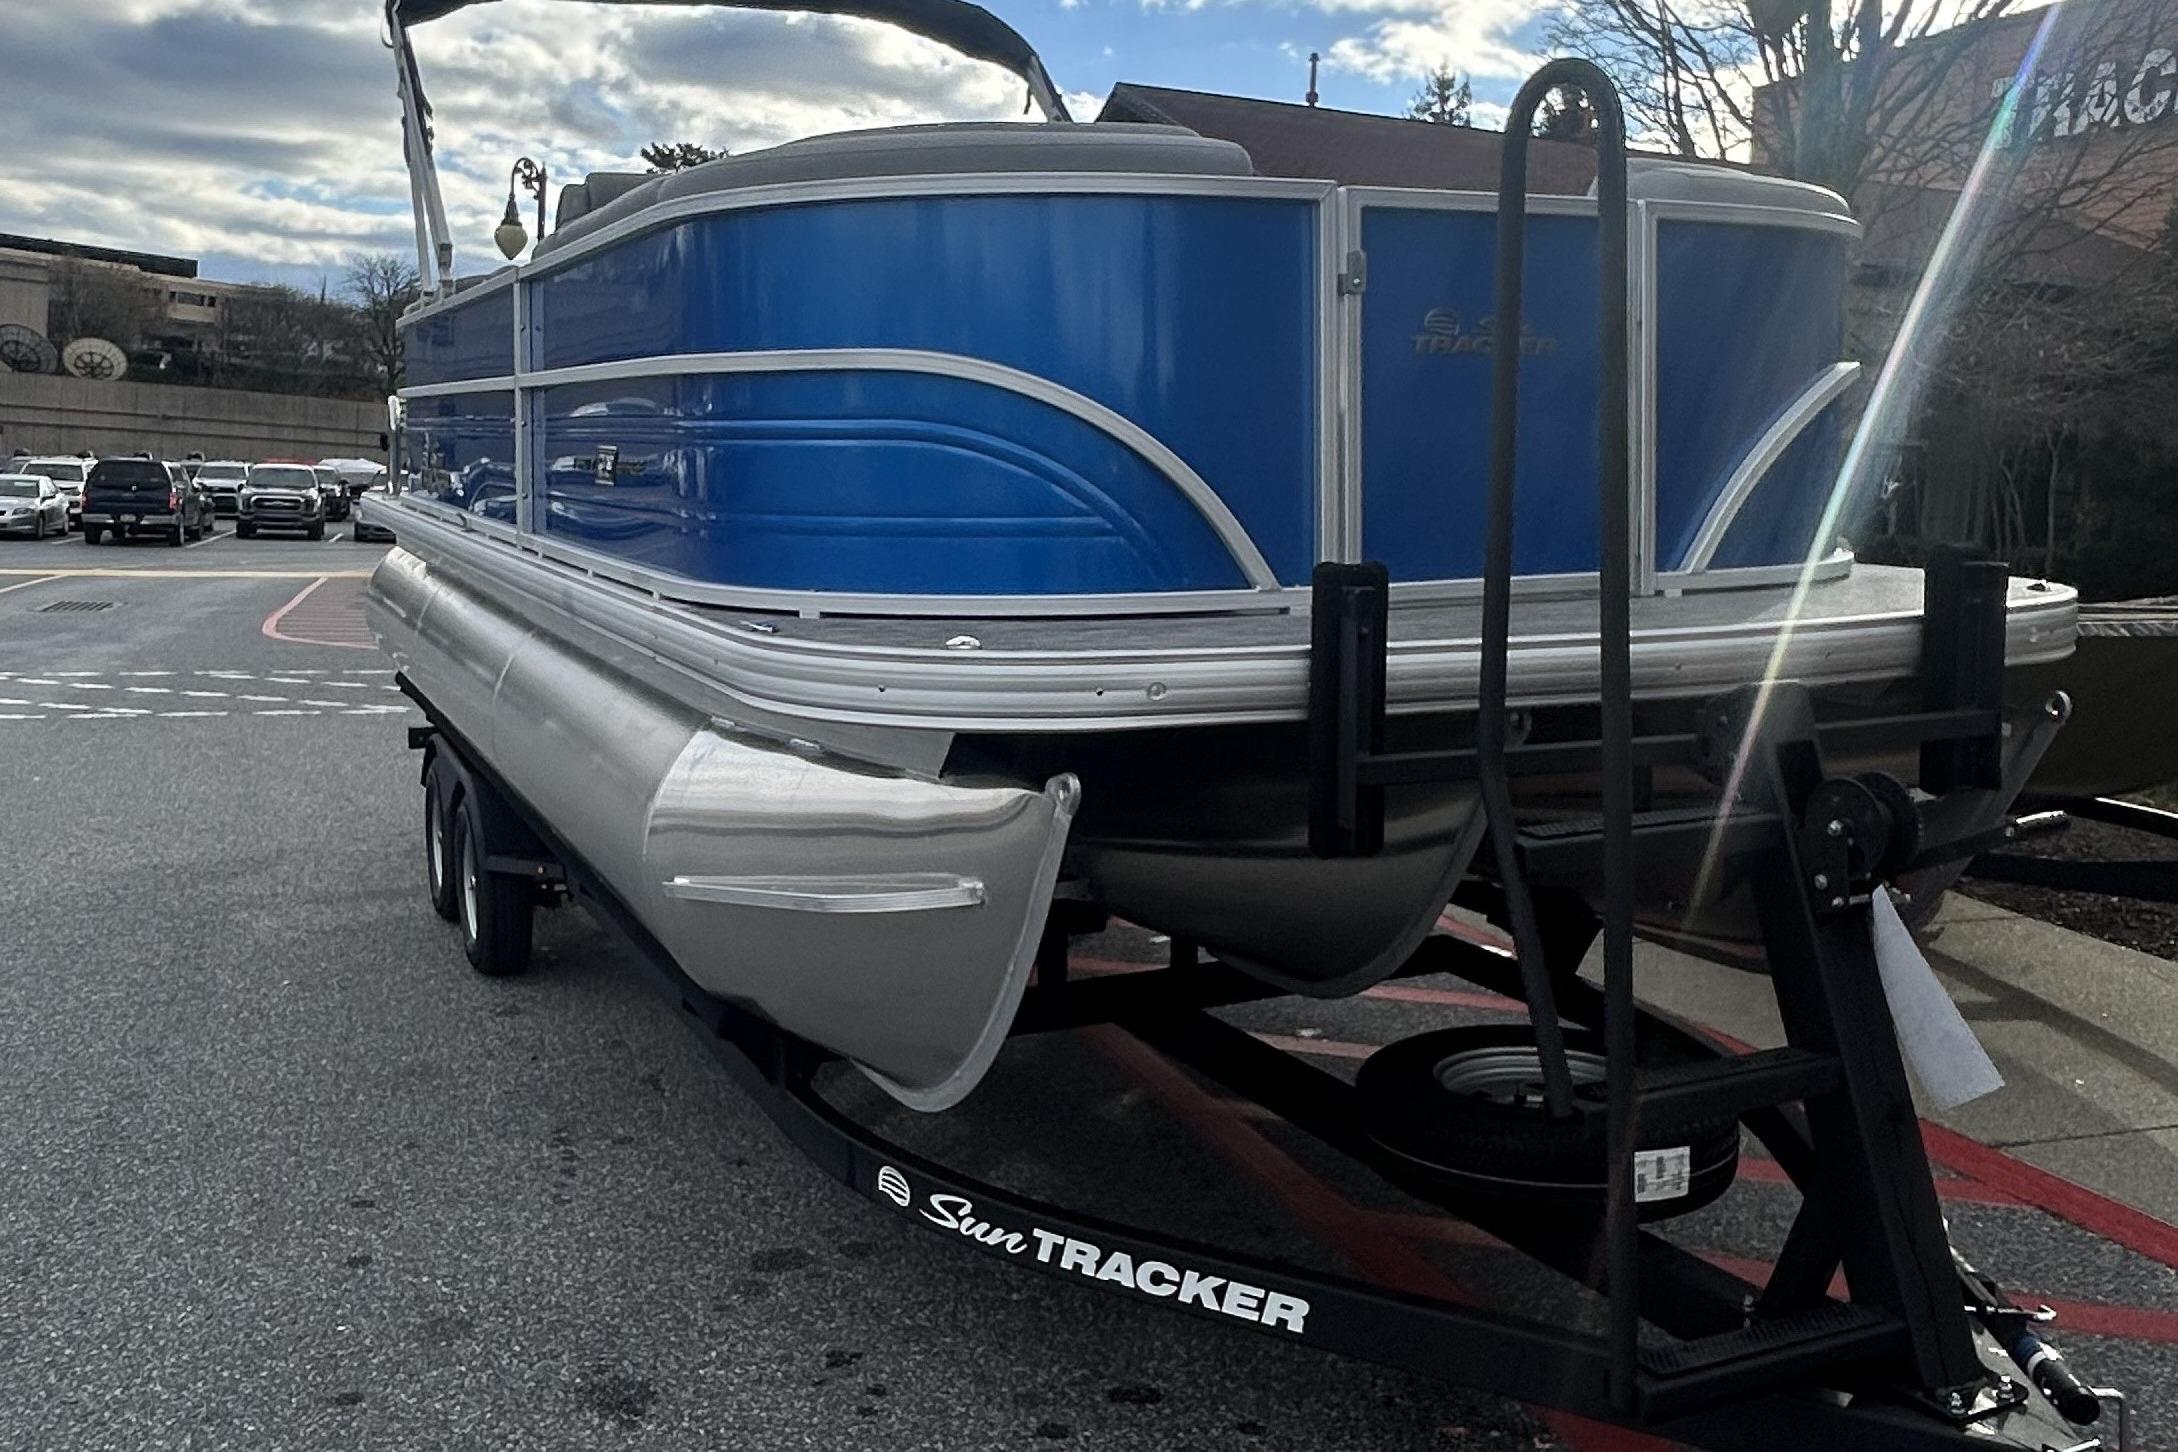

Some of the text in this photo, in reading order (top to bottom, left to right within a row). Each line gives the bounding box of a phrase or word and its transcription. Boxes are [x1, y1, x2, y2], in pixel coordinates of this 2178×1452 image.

[1991, 48, 2178, 149] TRAC
[1411, 334, 1558, 354] TRACER
[919, 1194, 1310, 1333] Sun TRACKER
